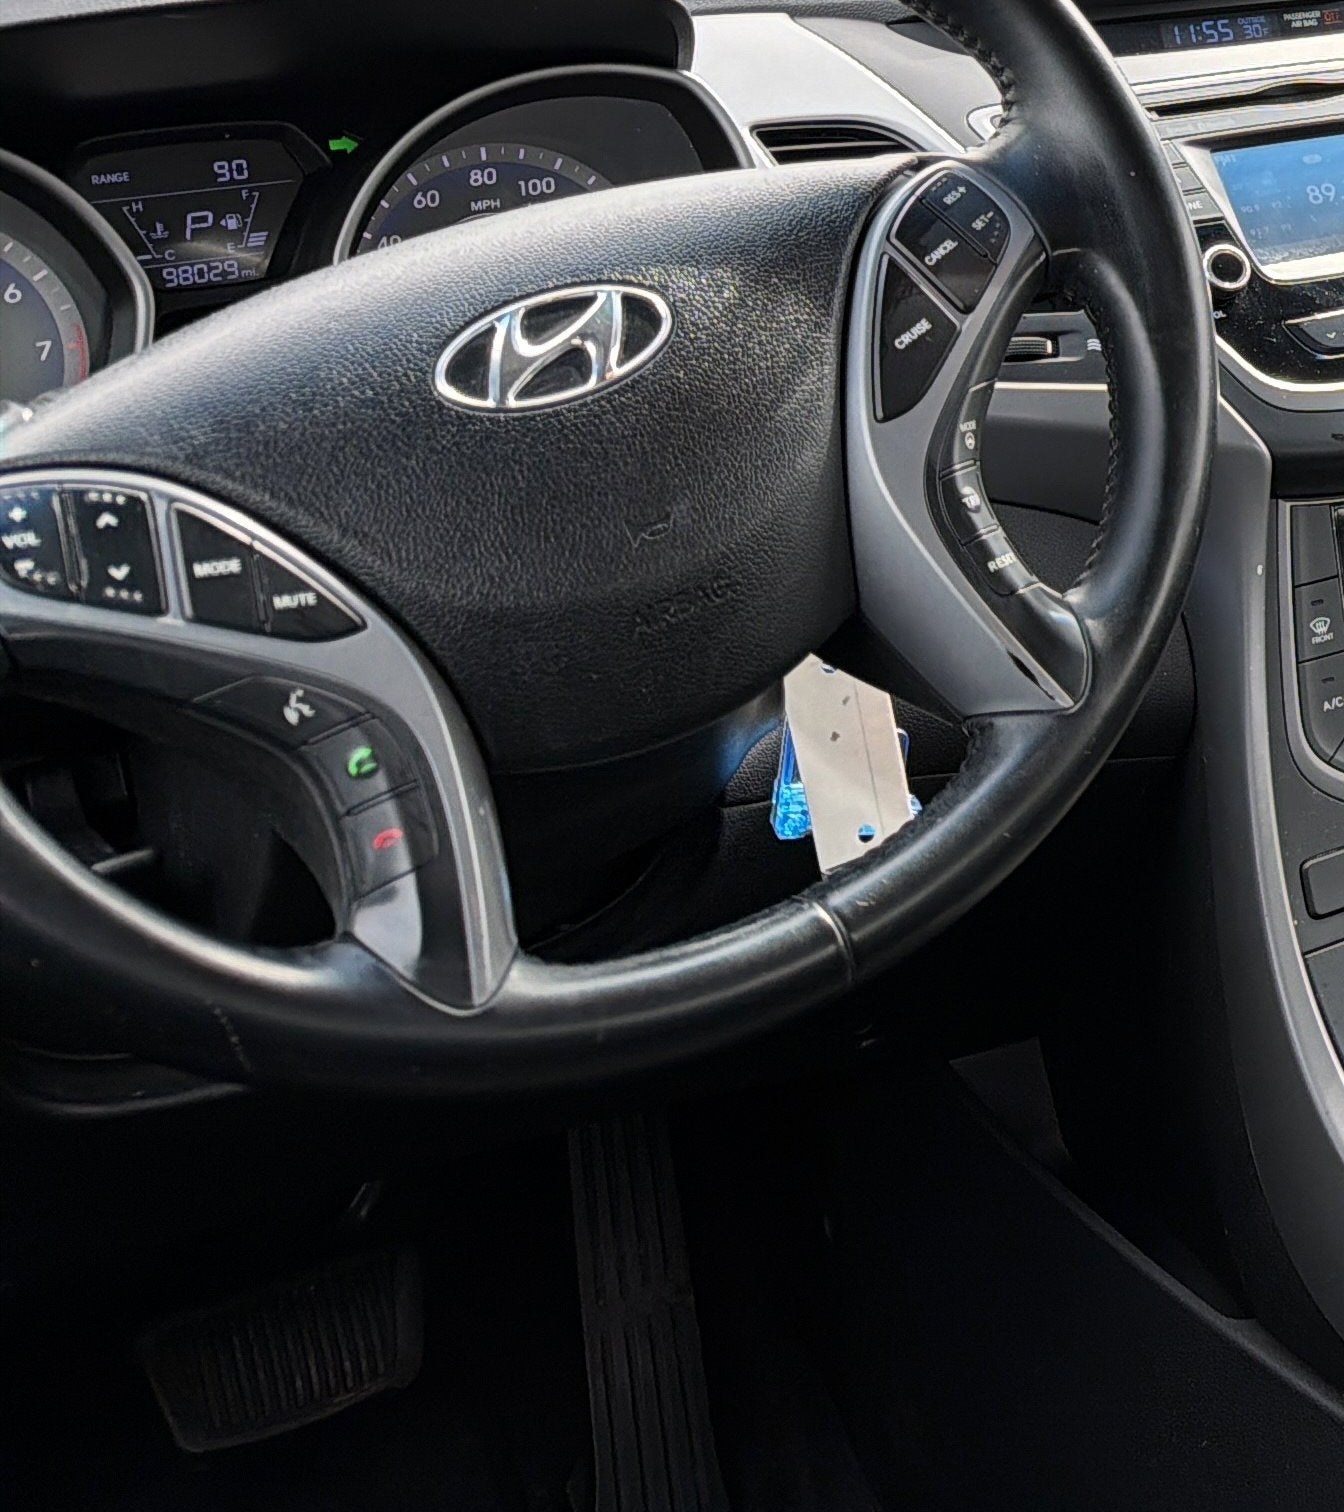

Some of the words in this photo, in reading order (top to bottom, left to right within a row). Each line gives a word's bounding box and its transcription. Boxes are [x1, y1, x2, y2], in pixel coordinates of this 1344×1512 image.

[1283, 9, 1322, 22] PASSENGER
[1303, 17, 1319, 28] BAG
[1172, 19, 1235, 45] 11:55
[91, 171, 131, 185] RANGE
[213, 159, 248, 182] 90
[469, 168, 497, 187] 80
[518, 177, 556, 197] 100
[413, 190, 440, 209] 60
[470, 198, 500, 211] MPH
[186, 211, 213, 240] P
[164, 250, 176, 261] C
[924, 239, 959, 267] CANCEL
[162, 260, 239, 287] 98029
[4, 283, 22, 304] 6
[894, 317, 932, 350] CRUISE
[35, 340, 52, 361] 7
[1, 530, 42, 550] VOL
[192, 556, 242, 579] MODE
[987, 552, 1018, 574] RESET
[272, 592, 318, 611] MUTE
[1311, 633, 1334, 645] FRONT
[1323, 696, 1344, 713] A/C
